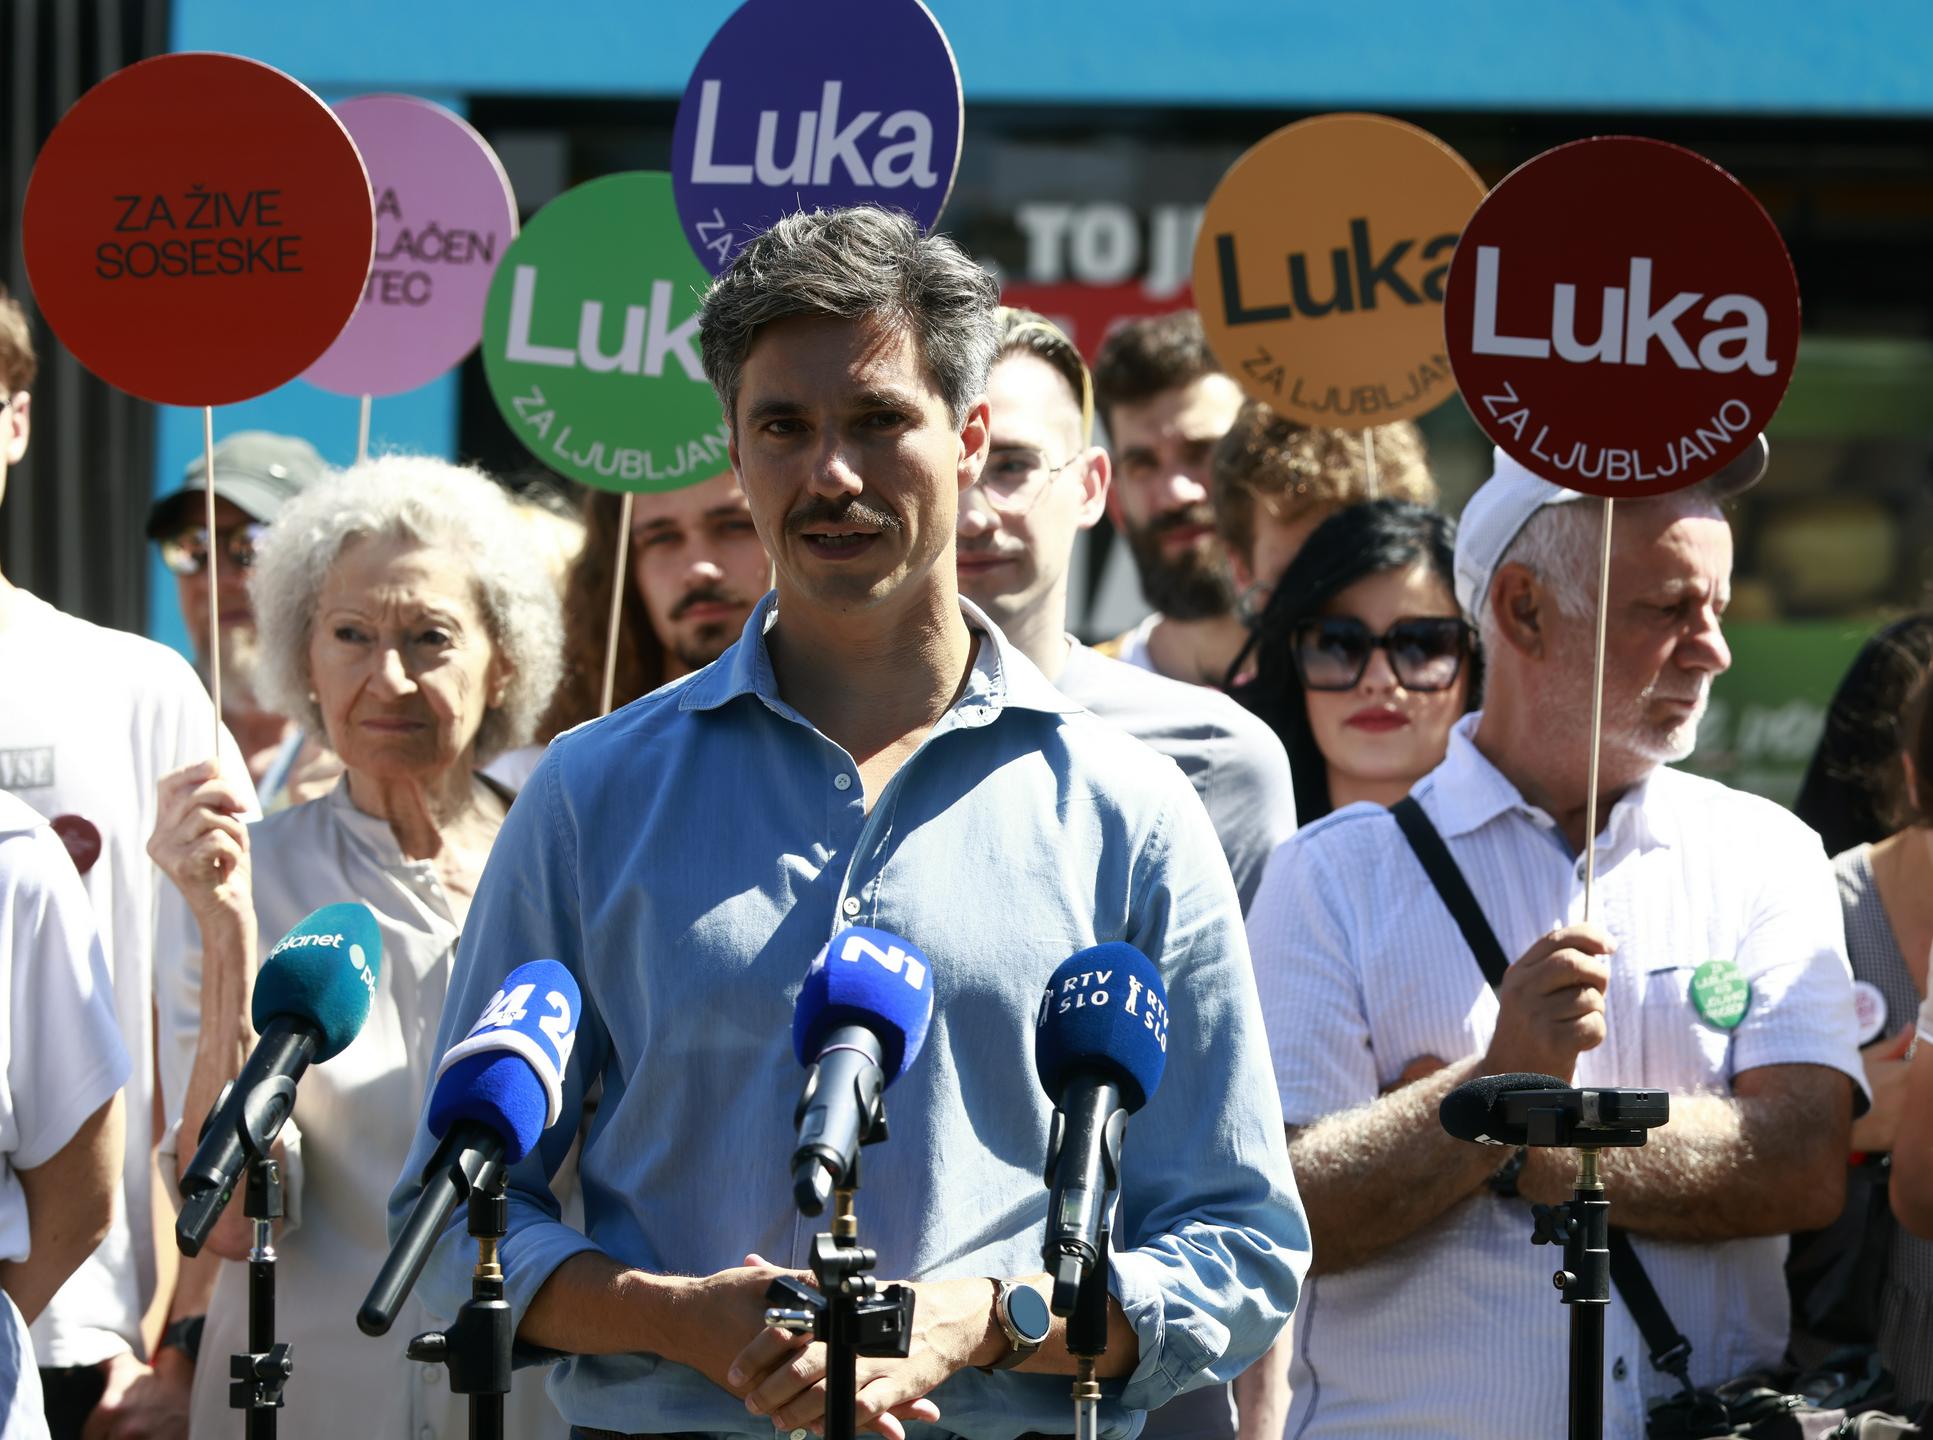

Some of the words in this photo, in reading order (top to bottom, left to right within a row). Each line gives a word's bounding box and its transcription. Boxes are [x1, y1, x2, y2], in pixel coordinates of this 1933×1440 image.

[691, 80, 938, 188] Luka
[115, 196, 176, 232] ZA
[185, 185, 282, 230] ŽIVE
[374, 186, 402, 221] A
[95, 235, 303, 280] SOSESKE
[375, 221, 496, 265] LAČEN
[695, 207, 733, 266] ZA
[1014, 202, 1138, 284] TO
[1143, 203, 1204, 298] J
[364, 268, 432, 307] TEC
[1215, 217, 1462, 325] Luka
[505, 265, 713, 384] Luk
[1472, 245, 1777, 377] Luka
[1241, 346, 1286, 396] ZA
[511, 384, 556, 440] ZA
[553, 424, 731, 480] LJUBLJAN
[1482, 382, 1531, 441] ZA
[1530, 399, 1751, 482] LJUBLJANO
[840, 935, 926, 991] N1
[1062, 970, 1113, 993] RTV
[1058, 990, 1109, 1014] SLO
[1143, 1010, 1167, 1053] SLO
